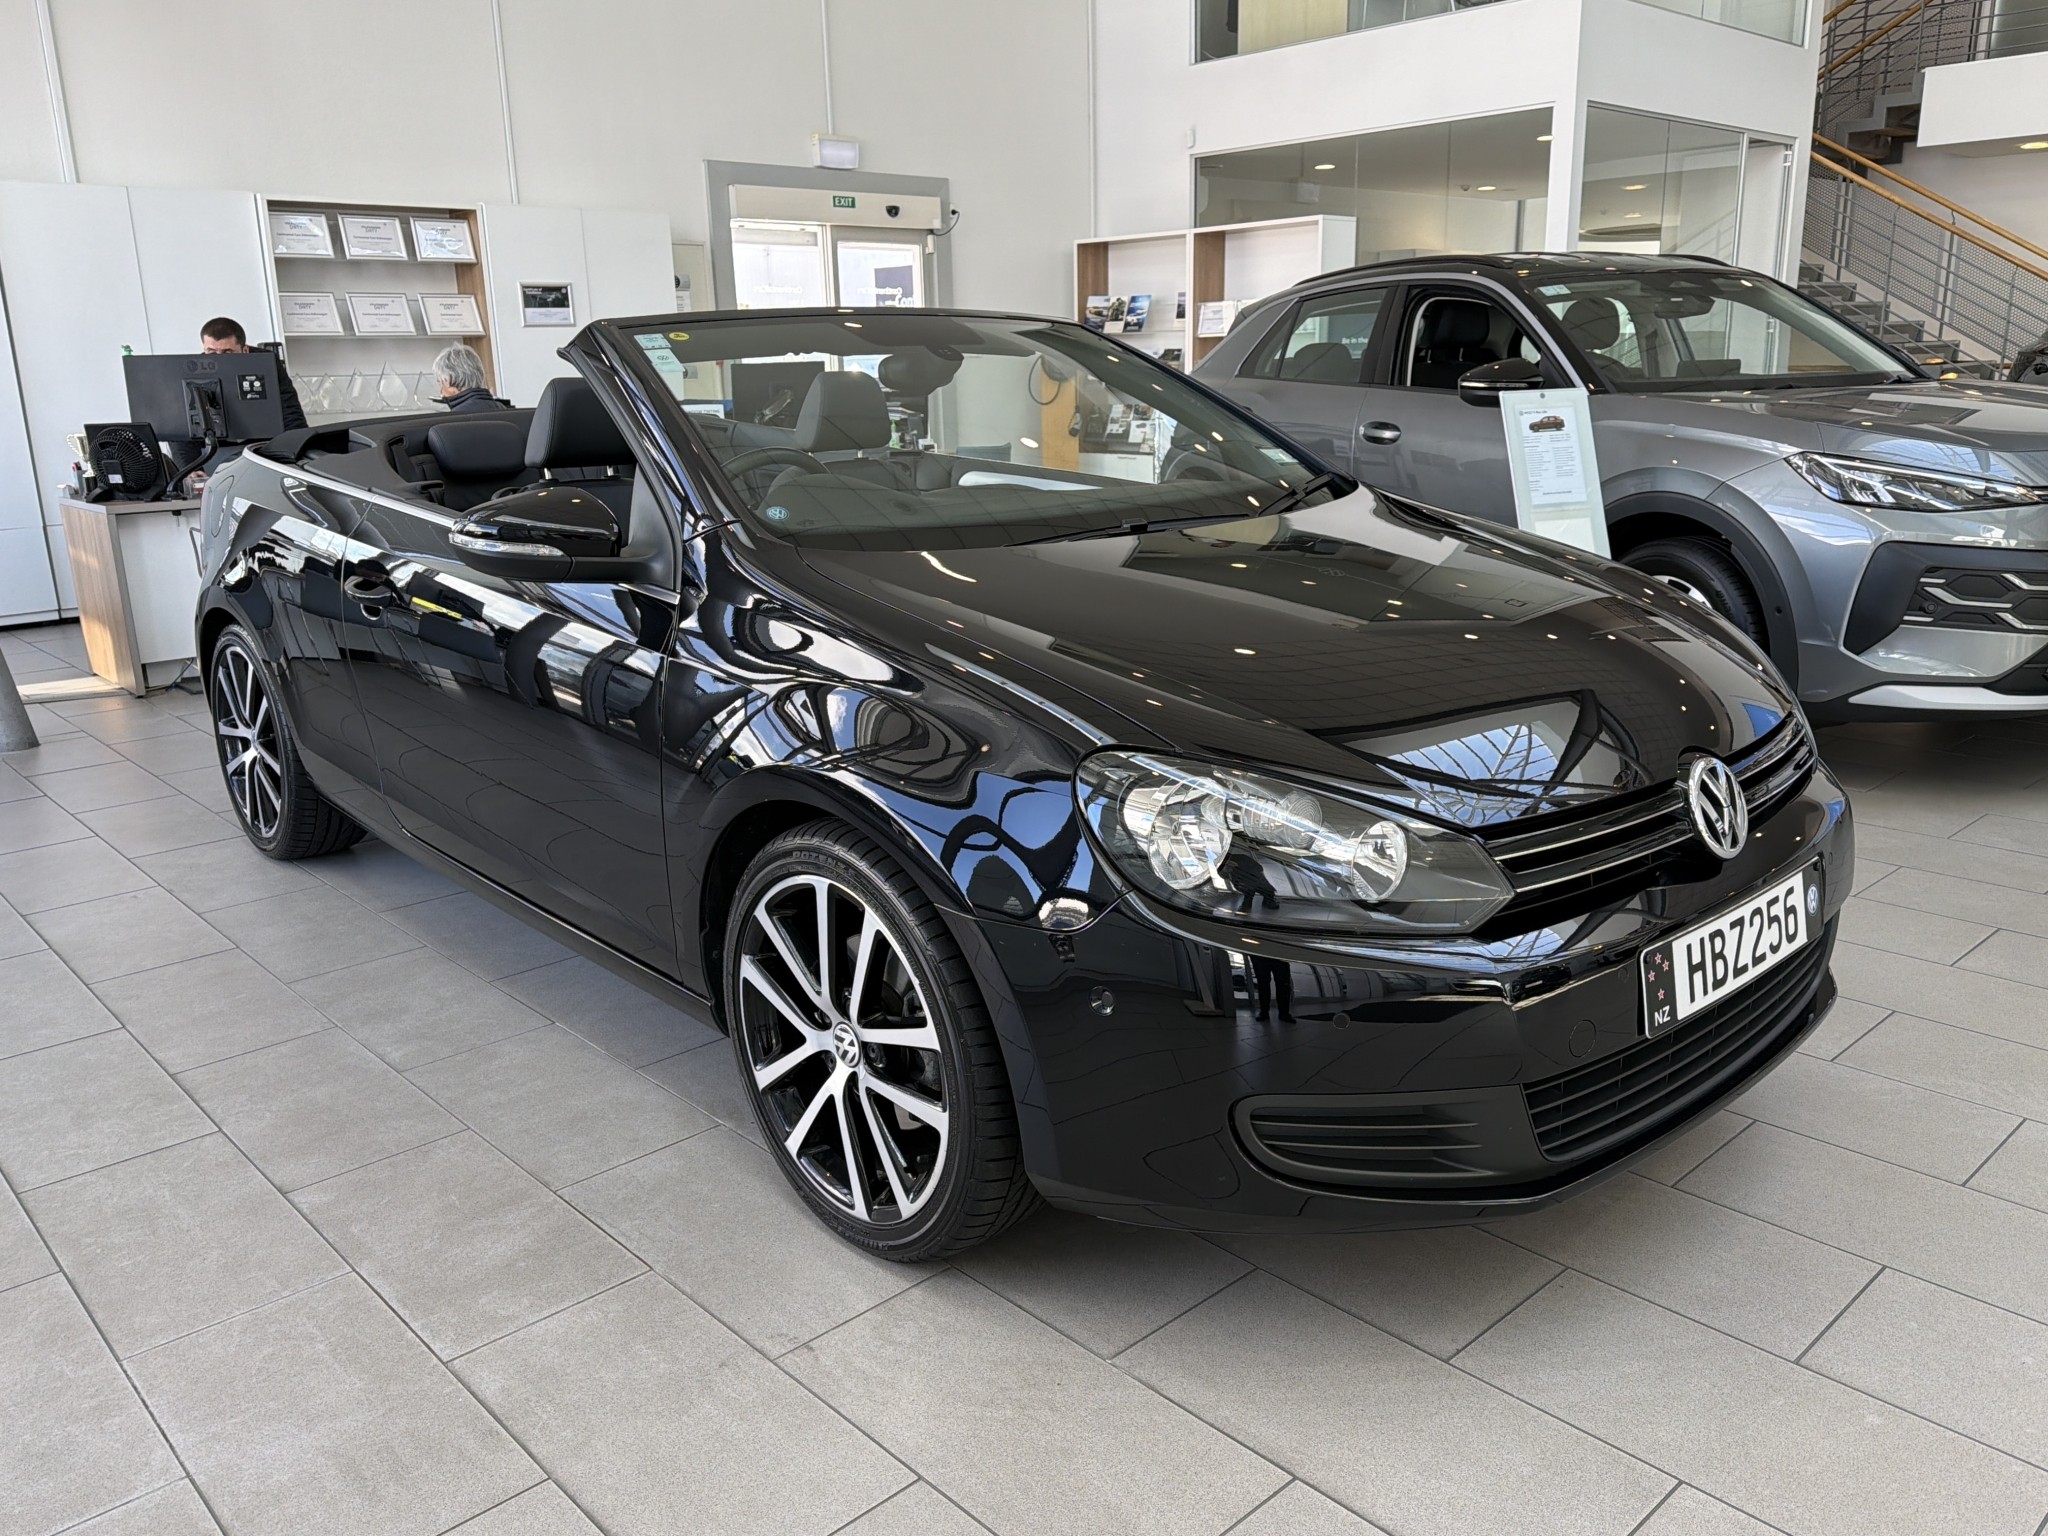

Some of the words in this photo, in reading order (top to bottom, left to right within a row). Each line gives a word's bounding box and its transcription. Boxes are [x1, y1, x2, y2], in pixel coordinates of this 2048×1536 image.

[835, 197, 853, 206] EXIT
[201, 361, 215, 370] LG
[1686, 886, 1798, 1004] HBZ256
[1654, 1006, 1670, 1027] NZ
